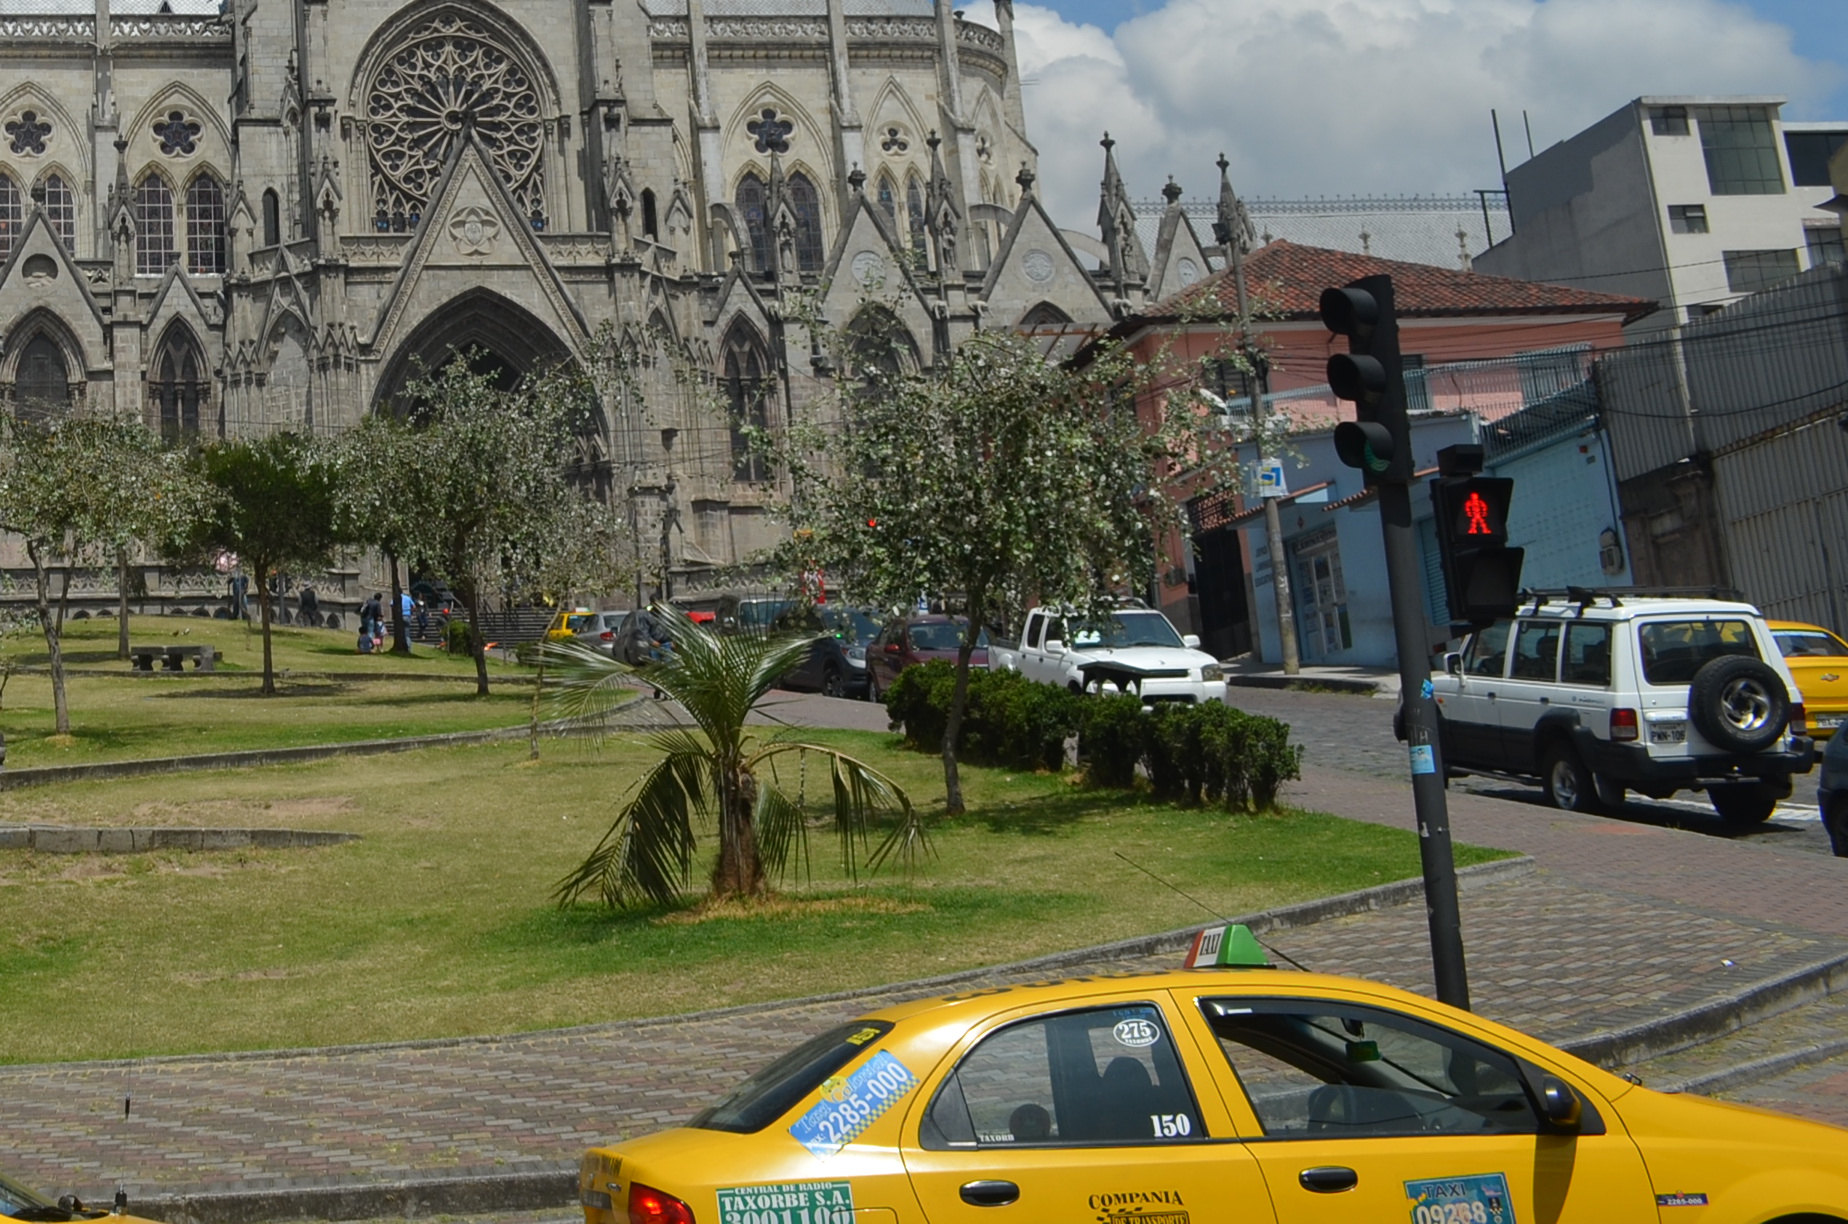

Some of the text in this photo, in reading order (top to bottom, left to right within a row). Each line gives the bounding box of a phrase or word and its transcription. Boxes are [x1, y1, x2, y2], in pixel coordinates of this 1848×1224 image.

[1119, 1022, 1152, 1039] 275
[819, 1062, 908, 1143] 2285-000
[1150, 1113, 1191, 1137] 150
[734, 1182, 832, 1195] CENTRAL DE RADIO
[1421, 1182, 1467, 1199] TAXI
[721, 1190, 850, 1211] TAXORBE S.A.
[1088, 1190, 1184, 1210] COMPANIA
